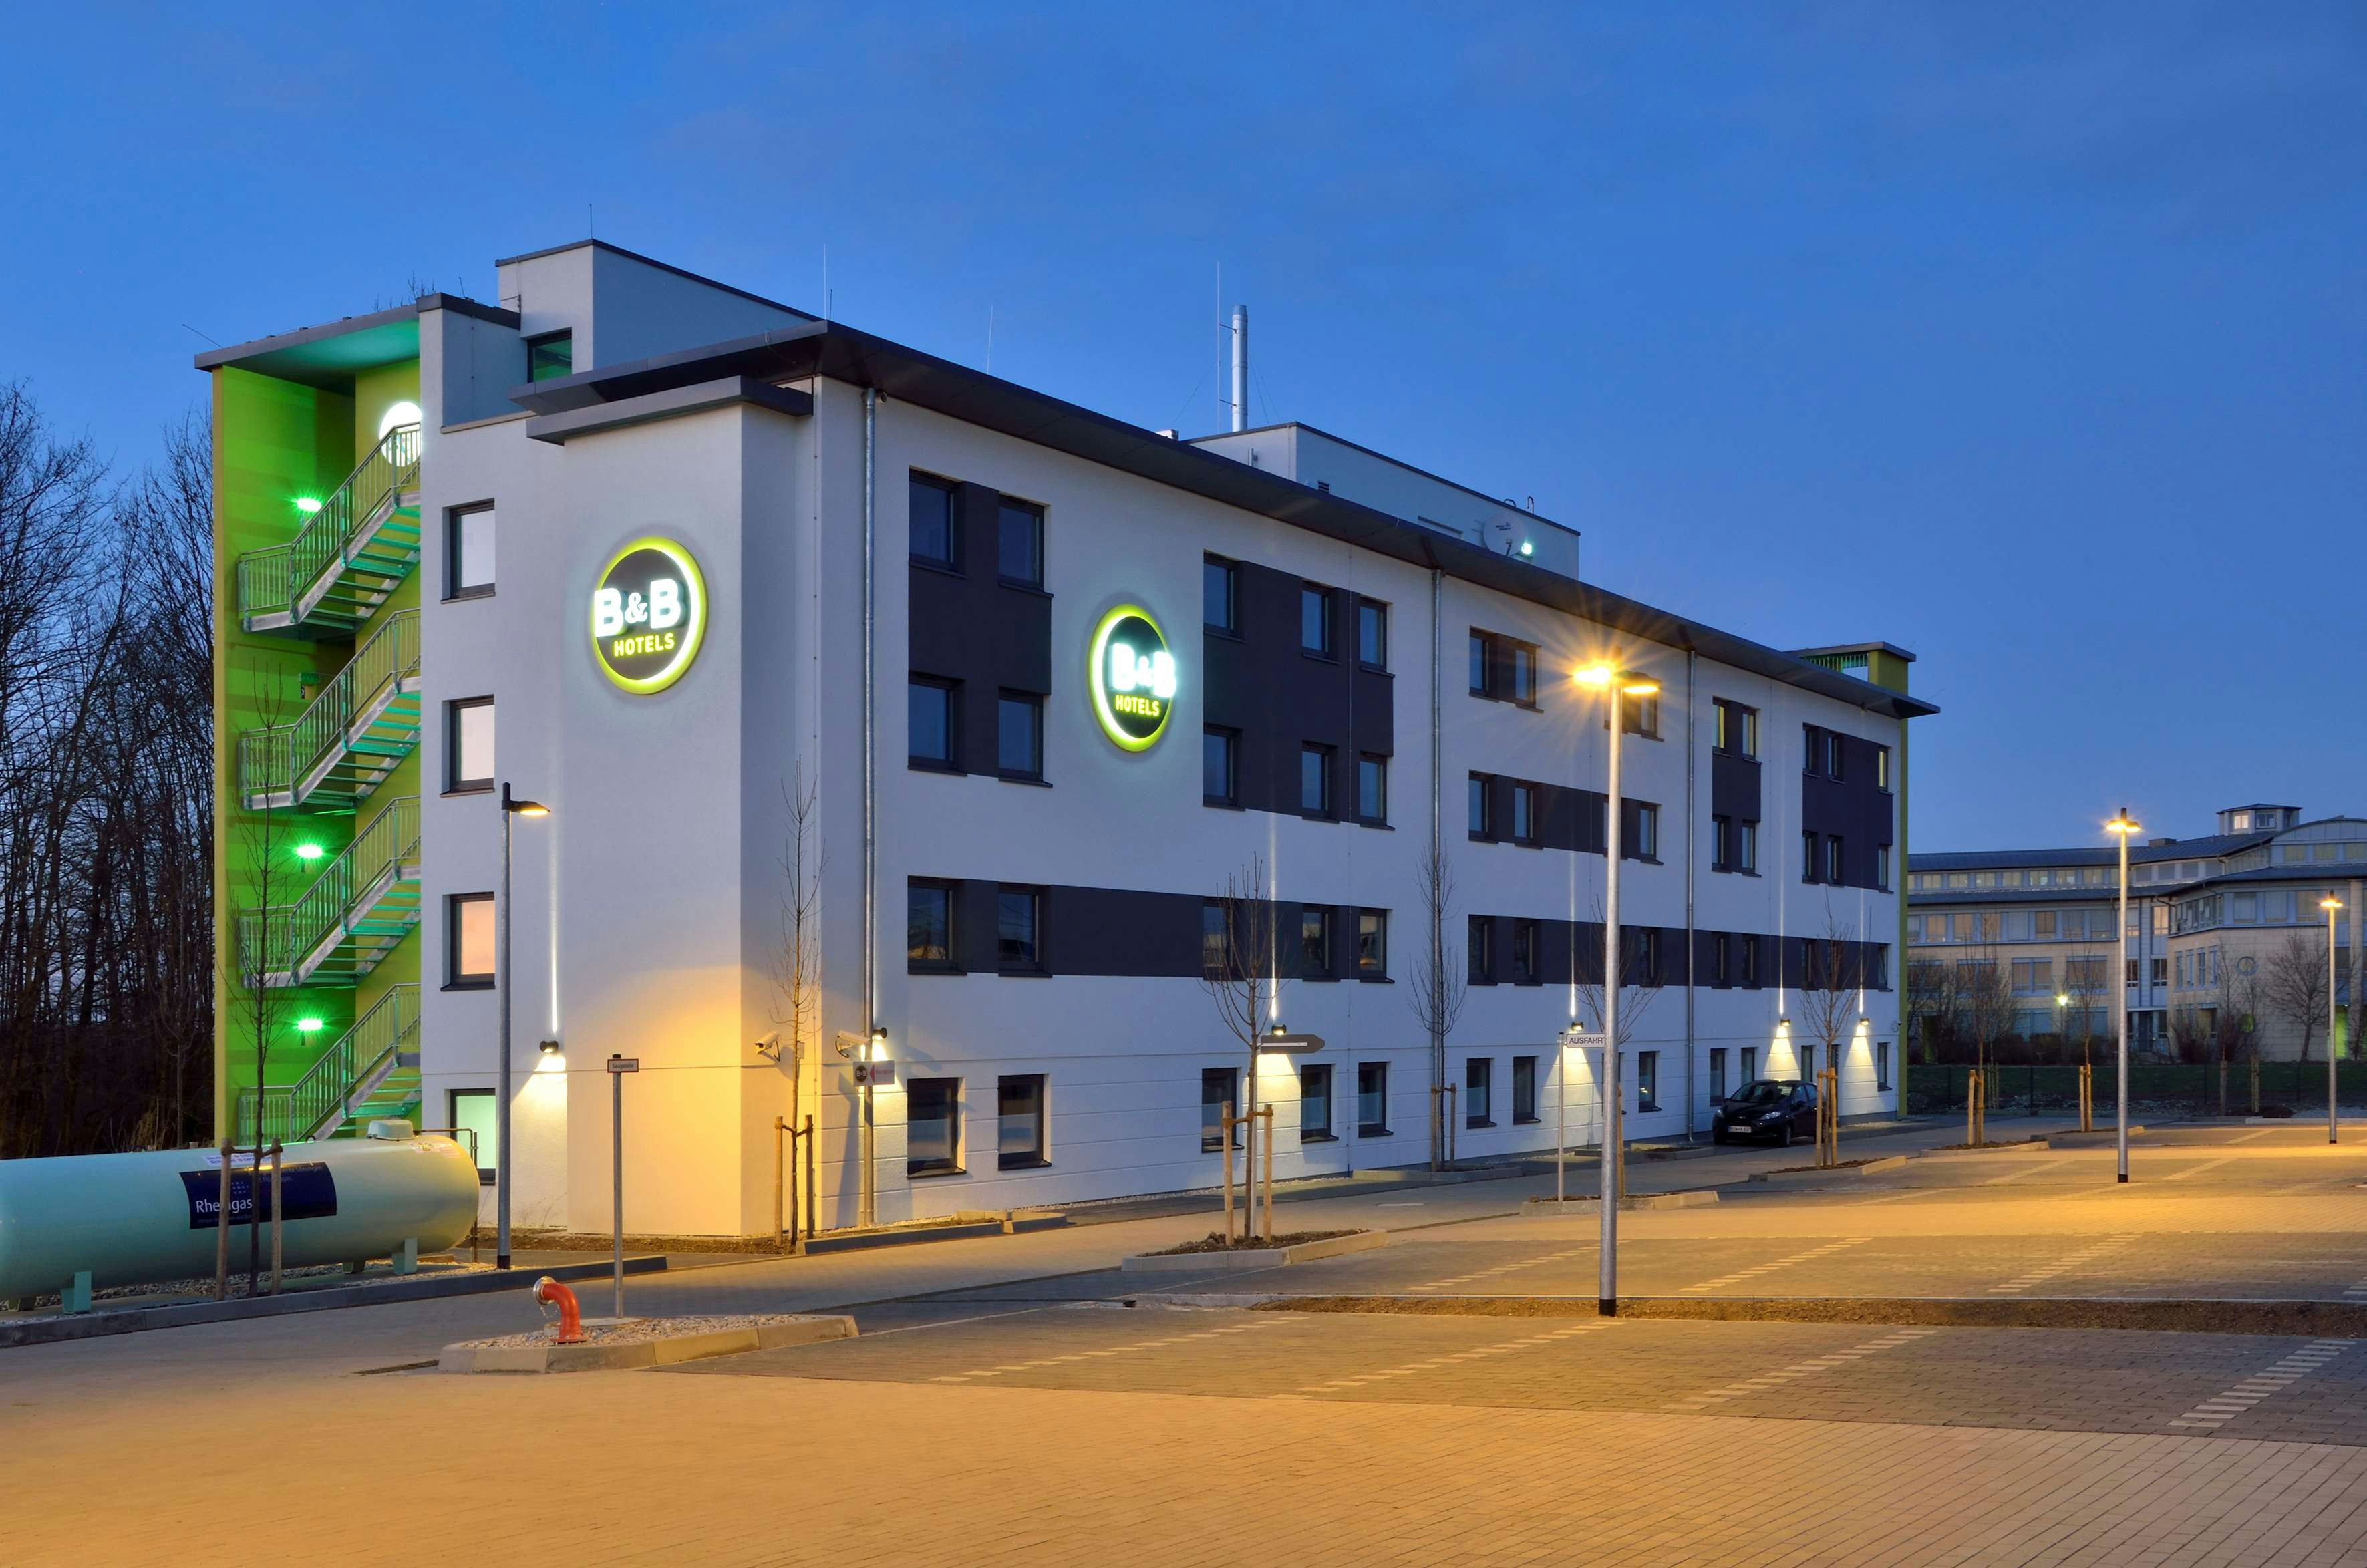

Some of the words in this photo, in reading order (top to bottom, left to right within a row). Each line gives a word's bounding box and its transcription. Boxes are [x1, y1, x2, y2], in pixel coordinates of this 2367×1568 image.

[594, 578, 681, 637] B&B
[613, 632, 675, 657] HOTELS
[1112, 643, 1176, 698] B&B
[1115, 694, 1160, 717] HOTELS
[196, 1198, 253, 1213] Rhegas
